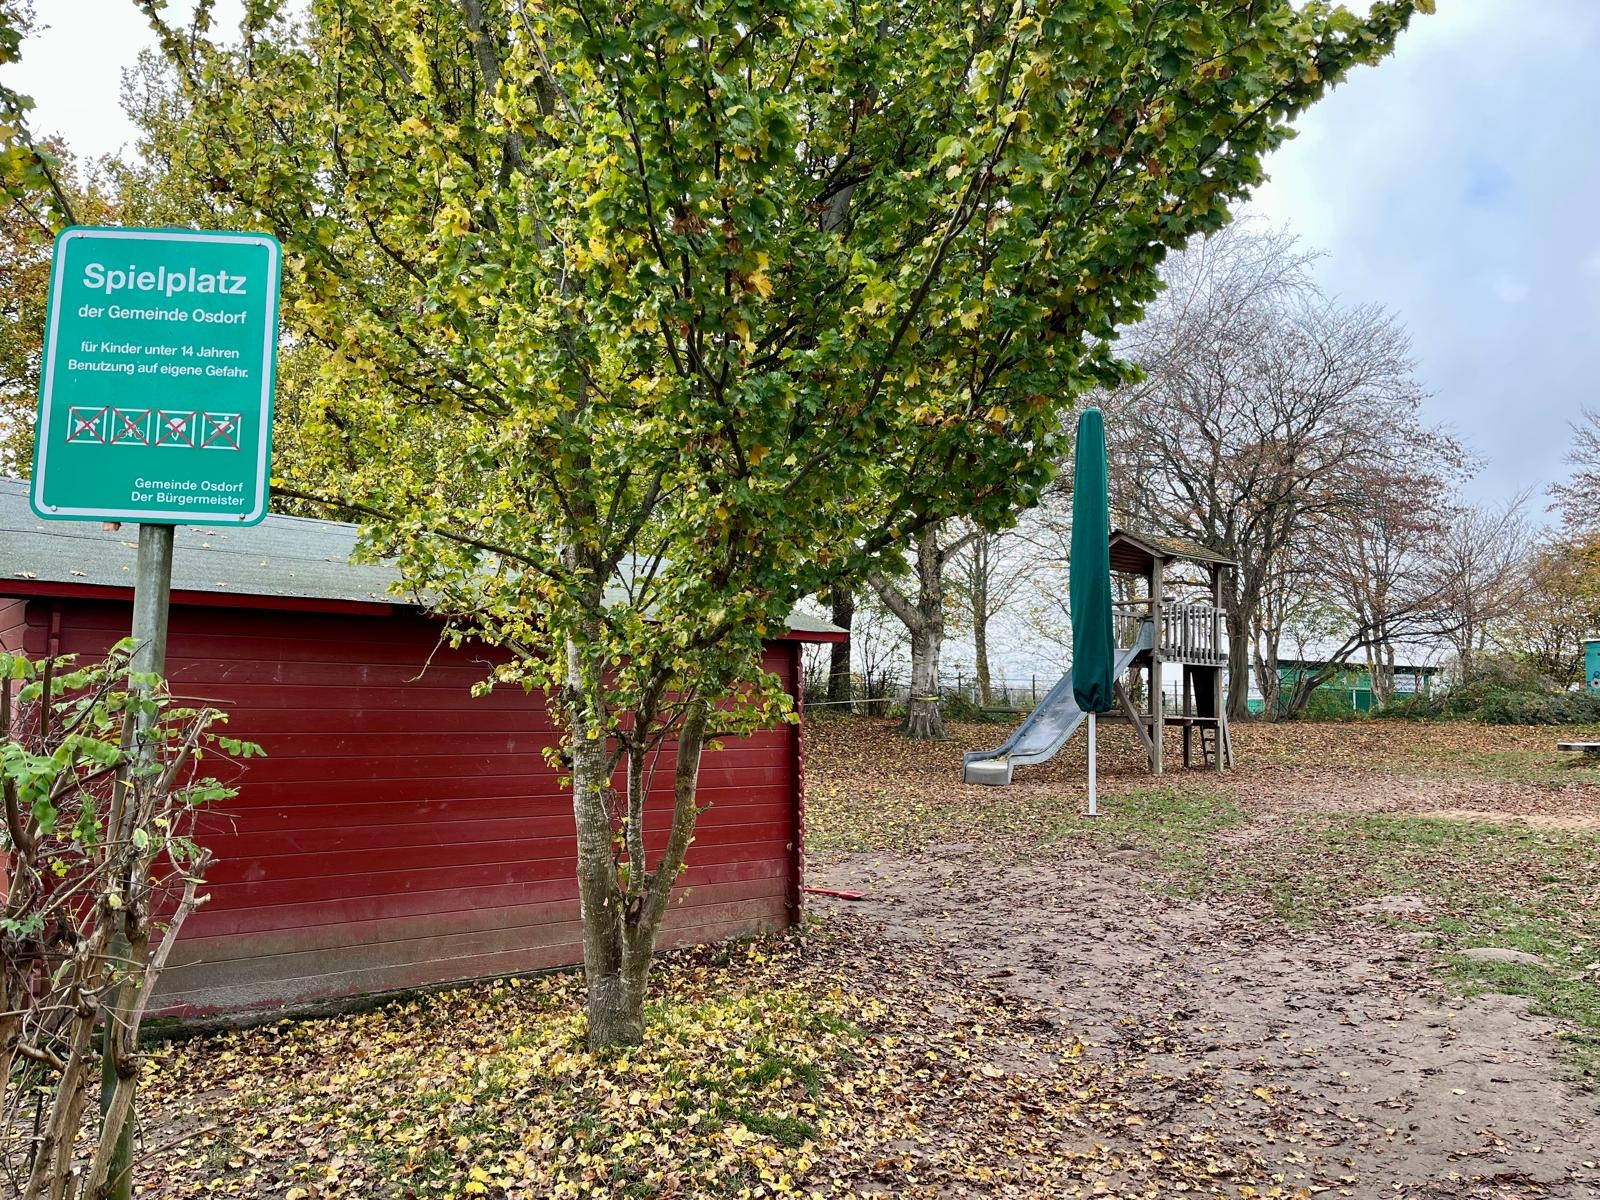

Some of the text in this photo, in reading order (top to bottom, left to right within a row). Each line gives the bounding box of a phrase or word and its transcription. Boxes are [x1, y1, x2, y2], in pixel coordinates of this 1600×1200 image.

[83, 263, 246, 296] Spielplatz
[78, 305, 247, 324] der Gemeinde Osdorf
[81, 341, 239, 358] für Kinder unter 14 Jahren
[68, 360, 248, 377] Benutzung auf eigene Gefahr.
[135, 478, 243, 492] Gemeinde Osdorf
[131, 492, 244, 506] Der Bürgermeister
